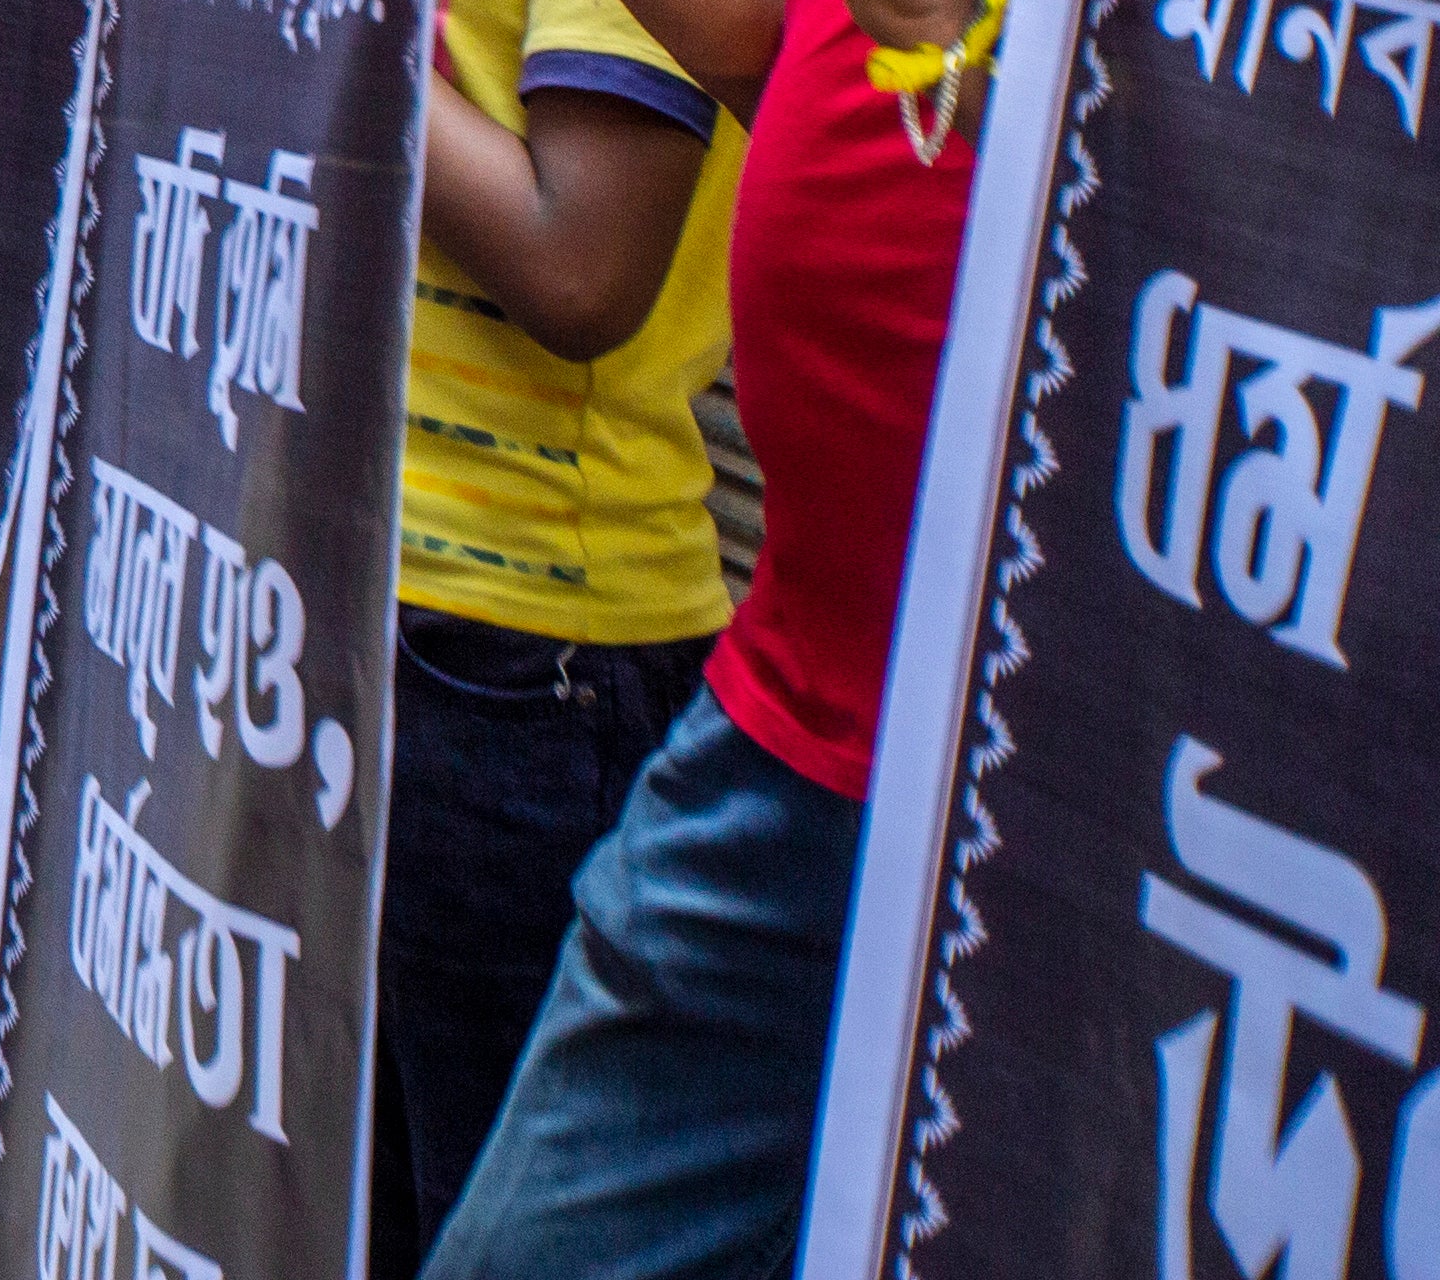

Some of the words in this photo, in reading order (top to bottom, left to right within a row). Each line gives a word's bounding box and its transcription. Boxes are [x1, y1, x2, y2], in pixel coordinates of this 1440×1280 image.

[134, 127, 228, 357] যদি
[217, 149, 319, 452] তুমি
[1112, 266, 1440, 672] ধর্ম
[85, 454, 197, 760] মানুষ
[198, 522, 359, 833] হও,
